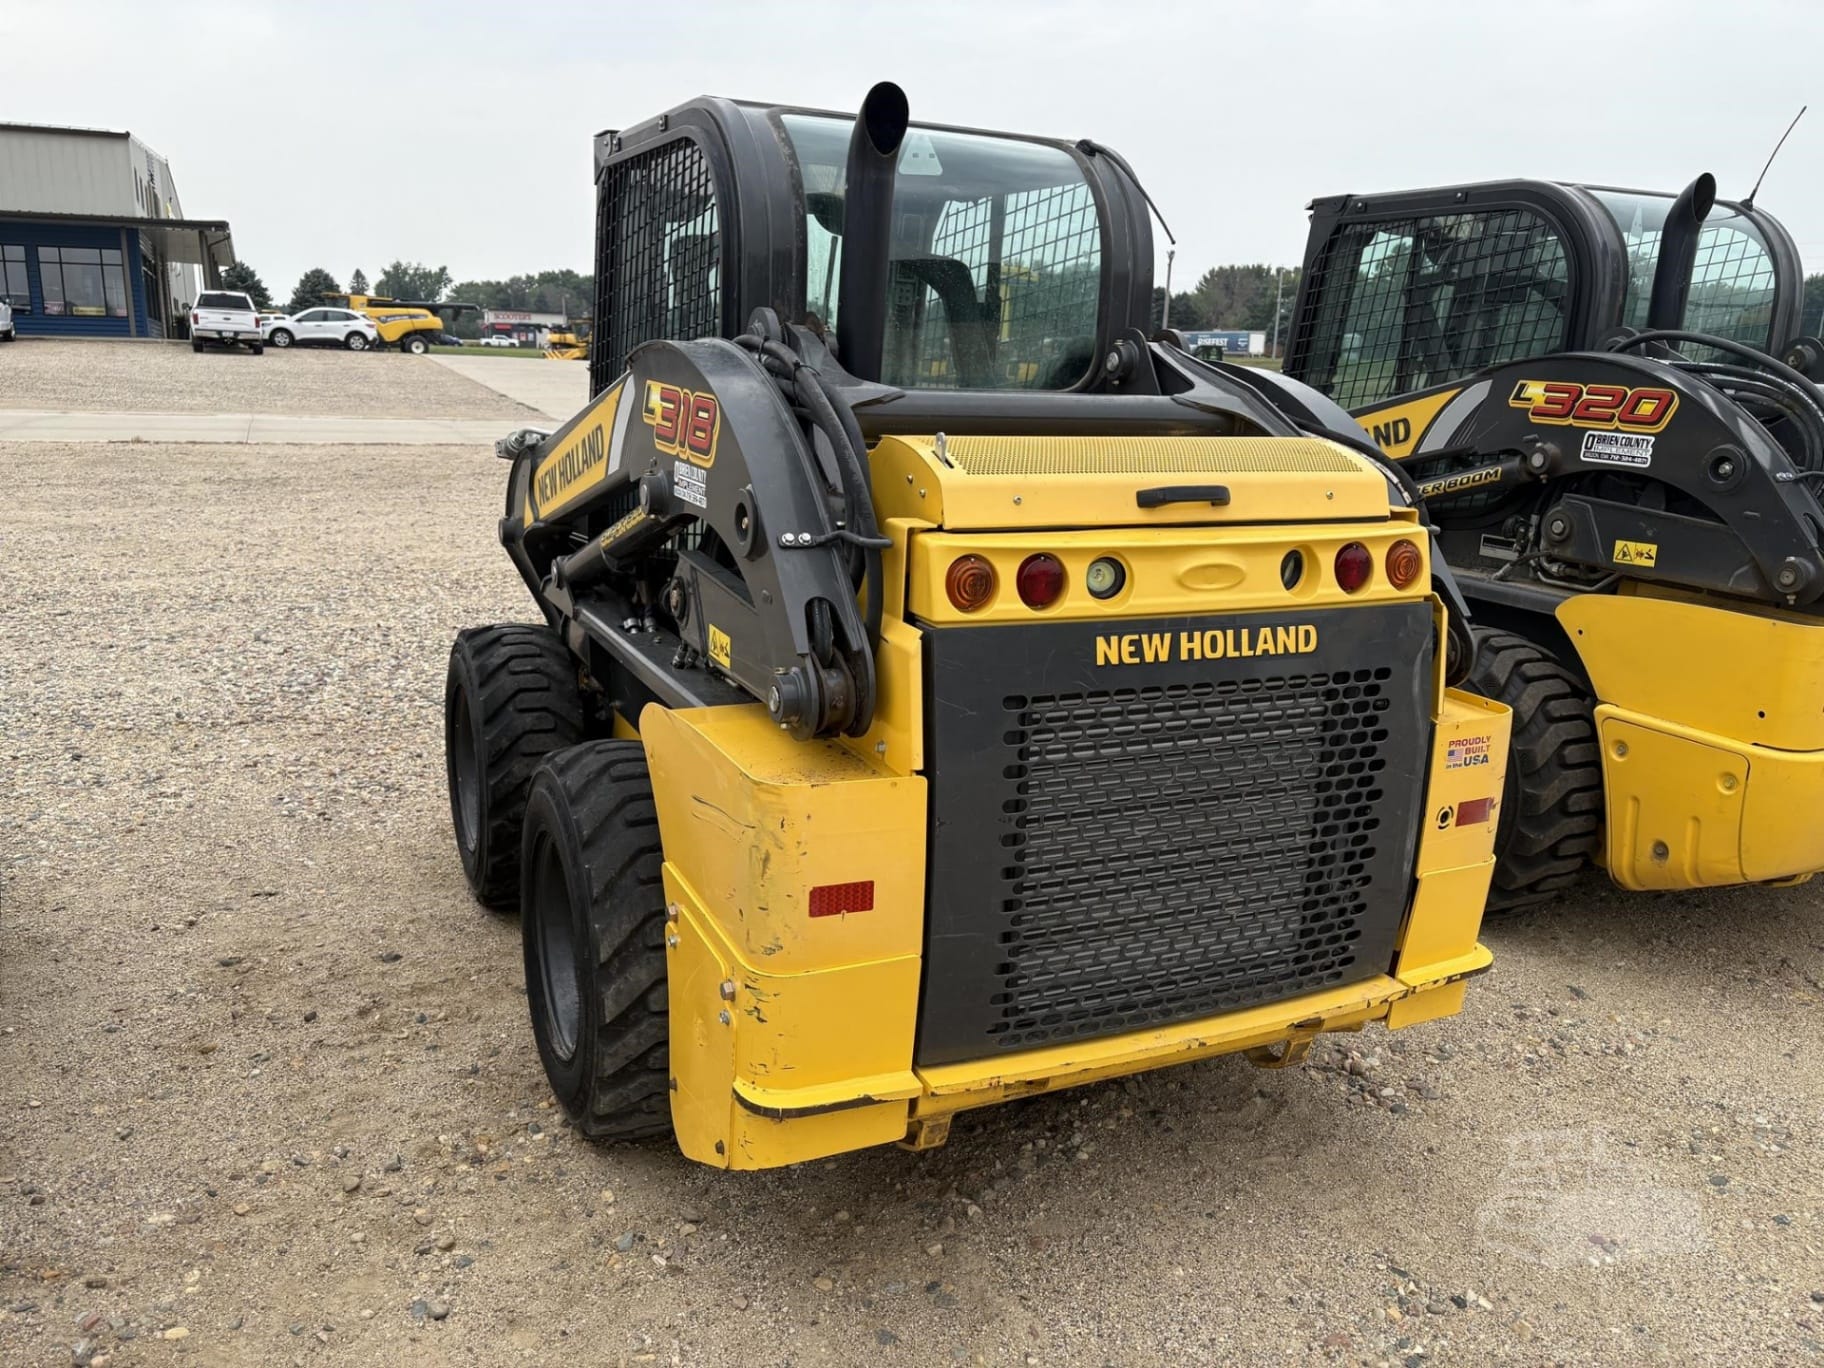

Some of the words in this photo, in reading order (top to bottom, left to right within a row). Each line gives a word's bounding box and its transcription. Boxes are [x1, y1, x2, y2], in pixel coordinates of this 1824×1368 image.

[1509, 380, 1679, 432] L320
[643, 380, 720, 467] L318
[1620, 436, 1653, 449] COUNTY
[537, 475, 558, 508] NEW
[558, 423, 605, 490] HOLLAND
[1445, 467, 1502, 491] BOOM
[1095, 632, 1172, 666] NEW
[1179, 624, 1318, 661] HOLLAND
[1448, 735, 1491, 748] PROUDLY
[1465, 745, 1490, 755] BUILT
[1464, 754, 1489, 767] USA
